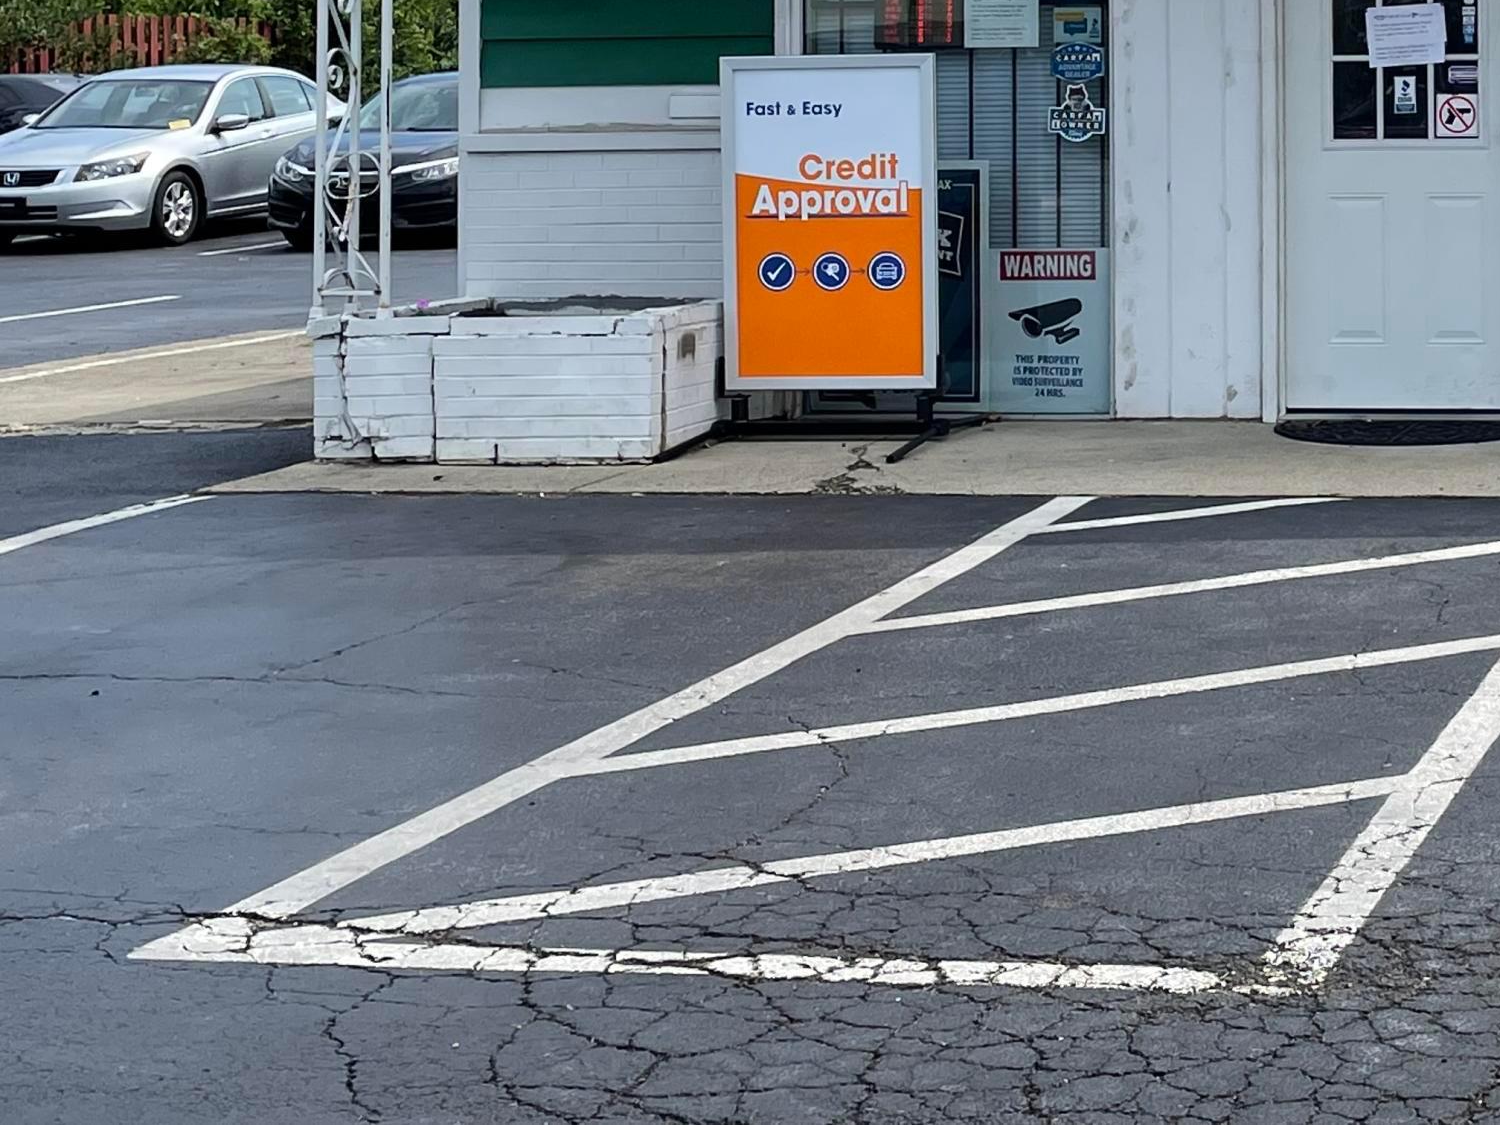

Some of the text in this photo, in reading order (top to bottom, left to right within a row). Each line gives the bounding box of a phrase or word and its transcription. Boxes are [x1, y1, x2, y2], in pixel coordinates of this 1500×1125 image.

[746, 101, 843, 118] Fast & Easy
[799, 153, 899, 181] Credit
[751, 180, 909, 222] Approval
[1004, 254, 1093, 278] WARNING
[1015, 354, 1081, 365] THIS PROPERTY
[1013, 366, 1084, 377] IS PROTECTED BY
[1011, 377, 1084, 388] VIDEO SURVEILLANCE
[1034, 388, 1046, 397] 24
